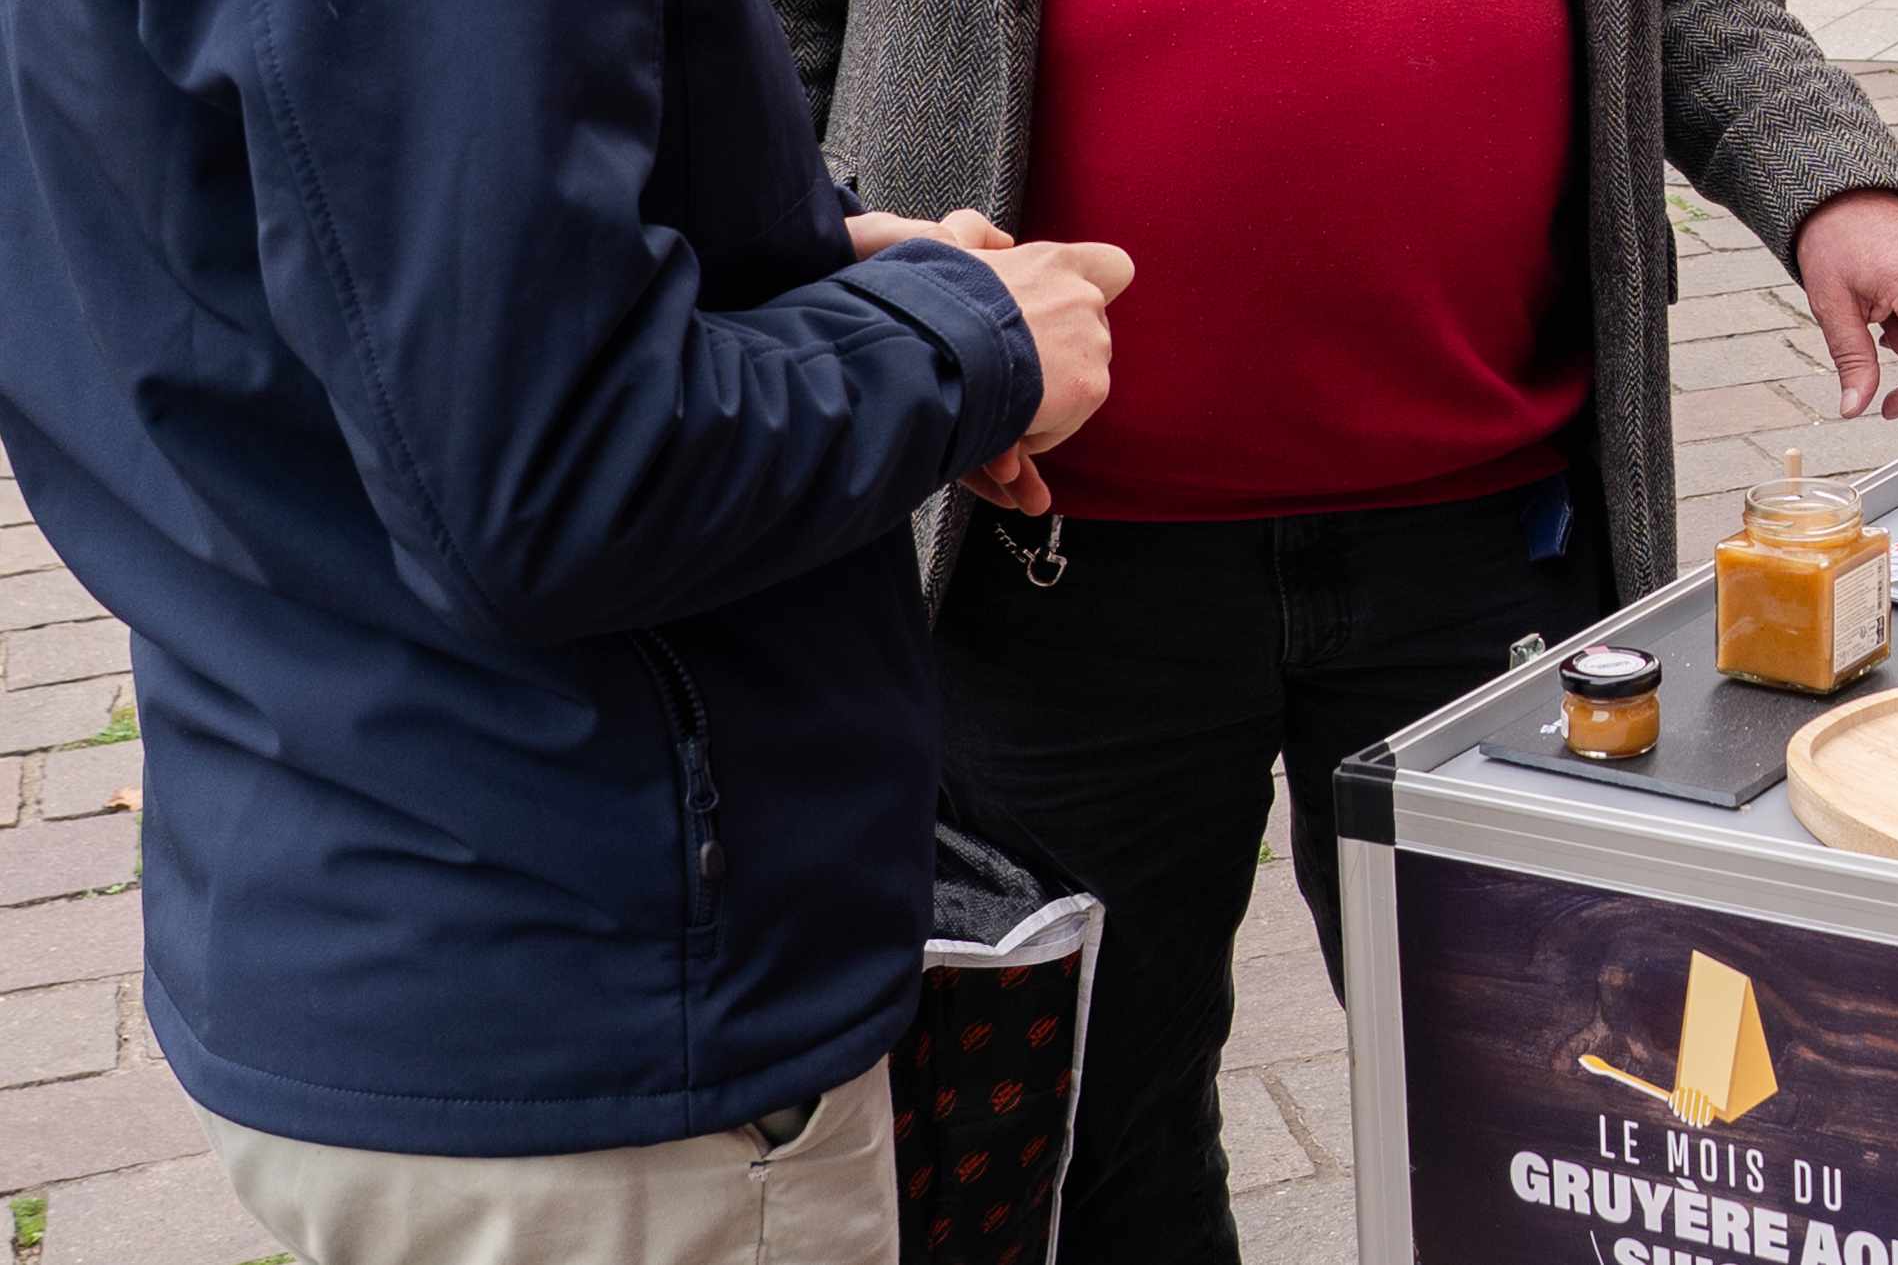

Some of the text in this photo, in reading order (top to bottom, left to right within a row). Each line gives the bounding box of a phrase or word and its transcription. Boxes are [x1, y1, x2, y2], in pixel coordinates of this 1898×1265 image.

[1509, 1151, 1790, 1263] GRUYÈRE
[1599, 1114, 1841, 1212] LE MOIS DU
